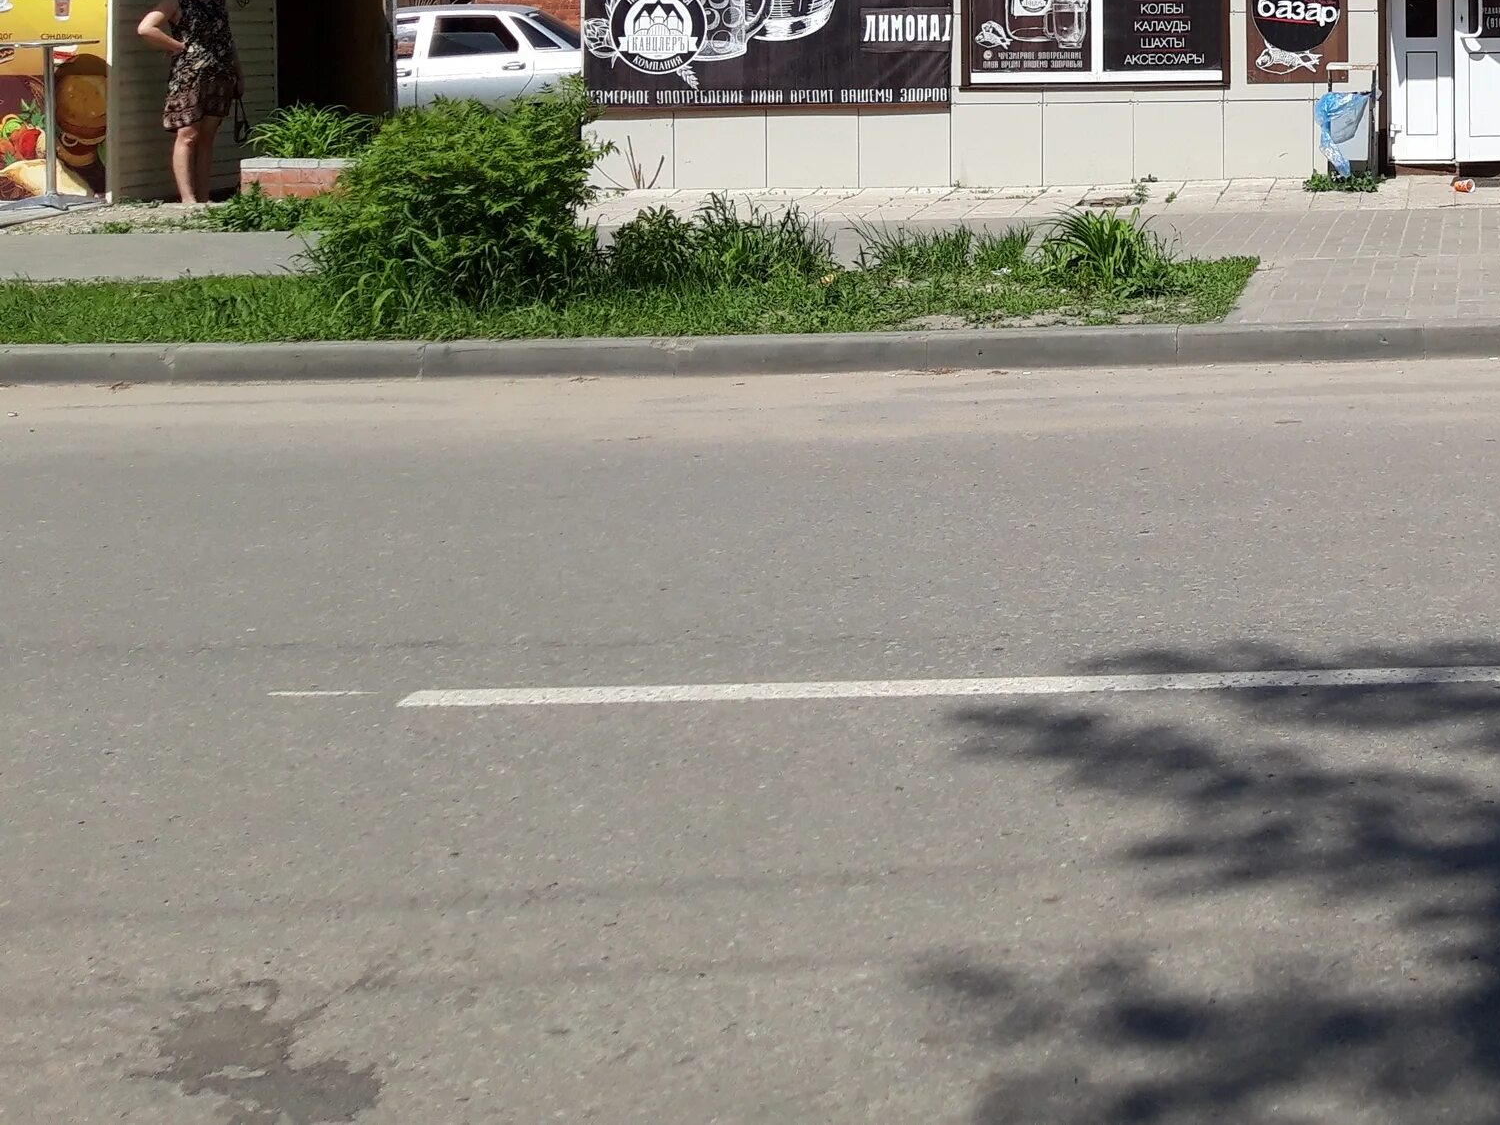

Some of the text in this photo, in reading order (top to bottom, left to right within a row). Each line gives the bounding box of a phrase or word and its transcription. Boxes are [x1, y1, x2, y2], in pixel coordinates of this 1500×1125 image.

[1140, 3, 1184, 14] КОЛБЫ
[1134, 21, 1191, 33] КАЛАУДЫ
[631, 36, 686, 52] КАНЦЛЕРЪ
[1140, 37, 1185, 48] ШАХТЫ
[632, 55, 683, 71] КОМПАНИЯ
[1124, 53, 1205, 65] АКСЕССУАРЫ
[656, 89, 744, 105] УПОТРЕБЛЕНИЕ
[750, 89, 783, 104] ПИВА
[790, 89, 834, 104] ВРЕДИТ
[841, 88, 893, 104] ВАШЕМУ
[900, 87, 950, 103] ЗДОРОВ
